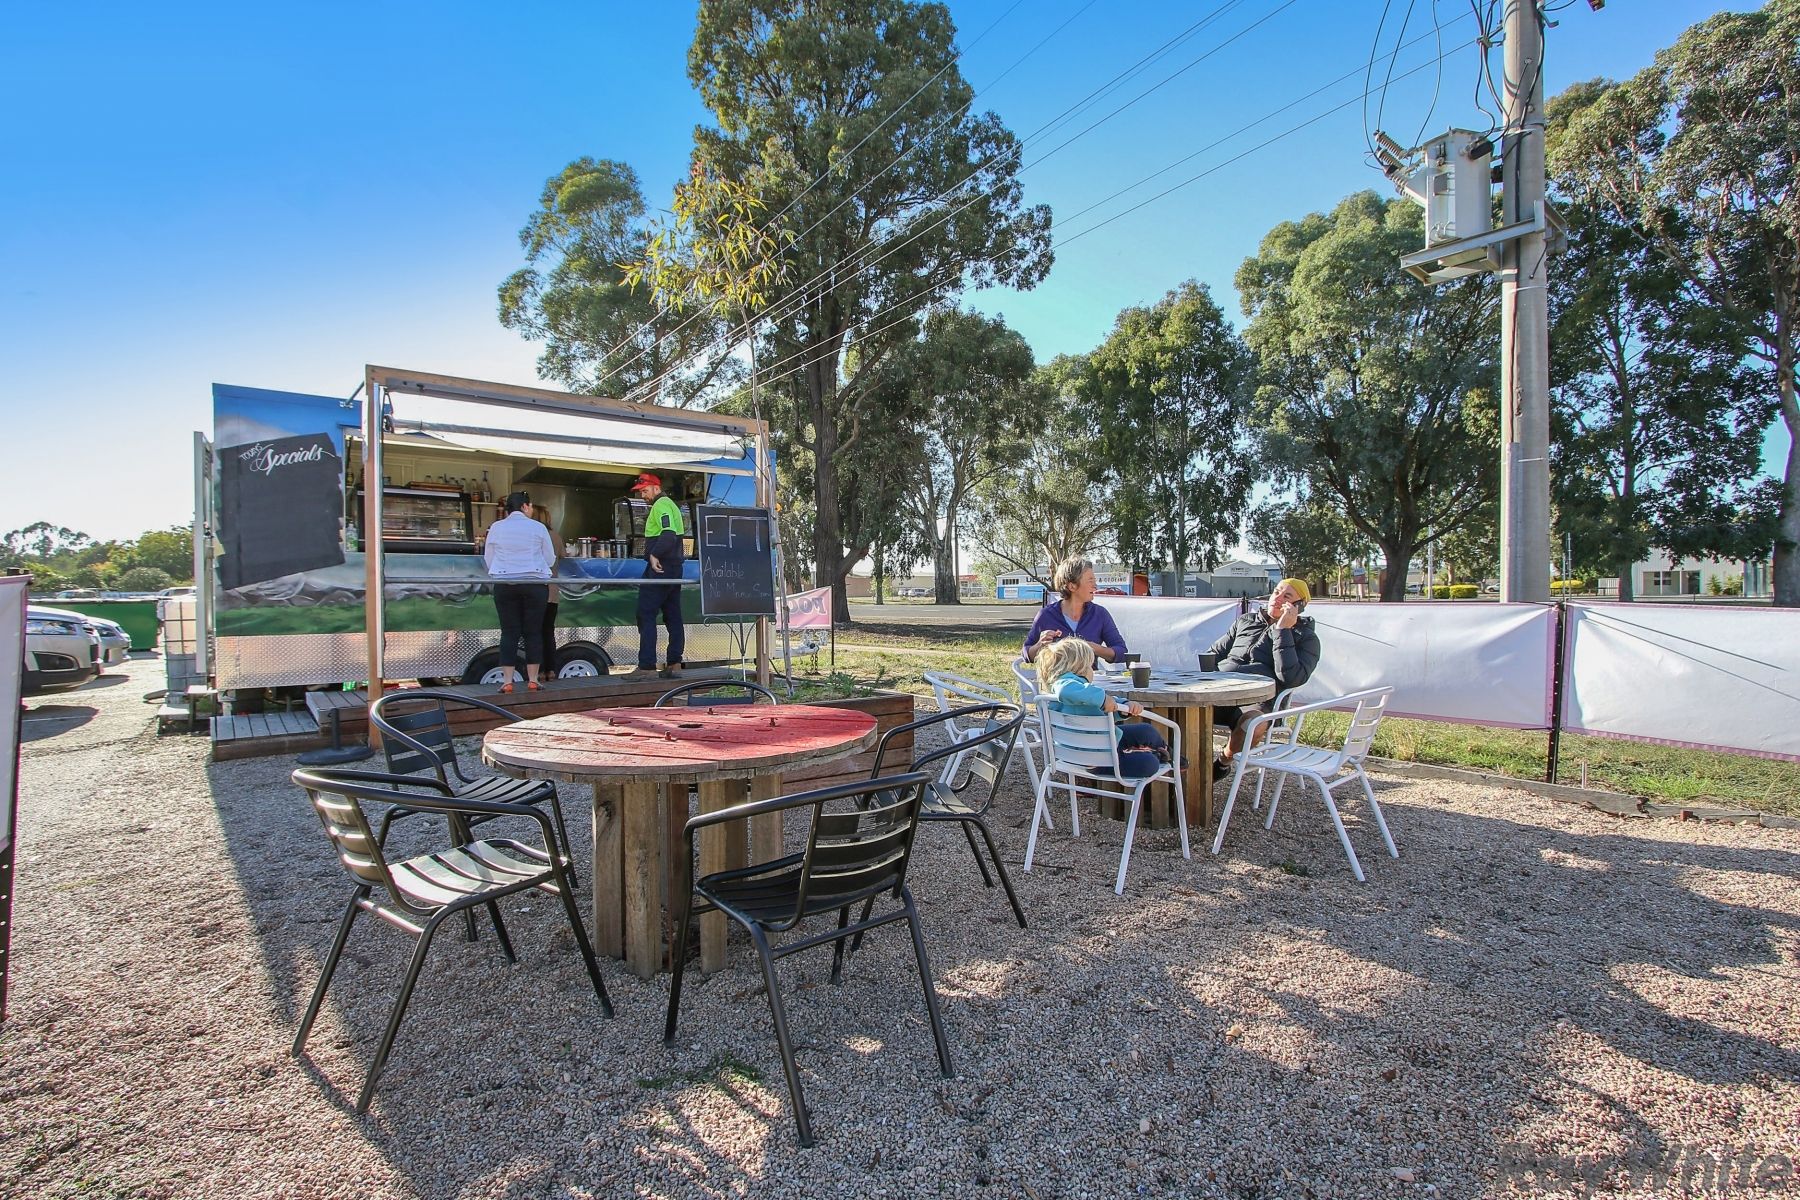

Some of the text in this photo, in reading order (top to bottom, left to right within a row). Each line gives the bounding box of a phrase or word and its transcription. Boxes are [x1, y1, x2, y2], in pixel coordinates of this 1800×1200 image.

[250, 443, 335, 476] Specials
[704, 515, 768, 552] EFT
[702, 556, 745, 579] Available
